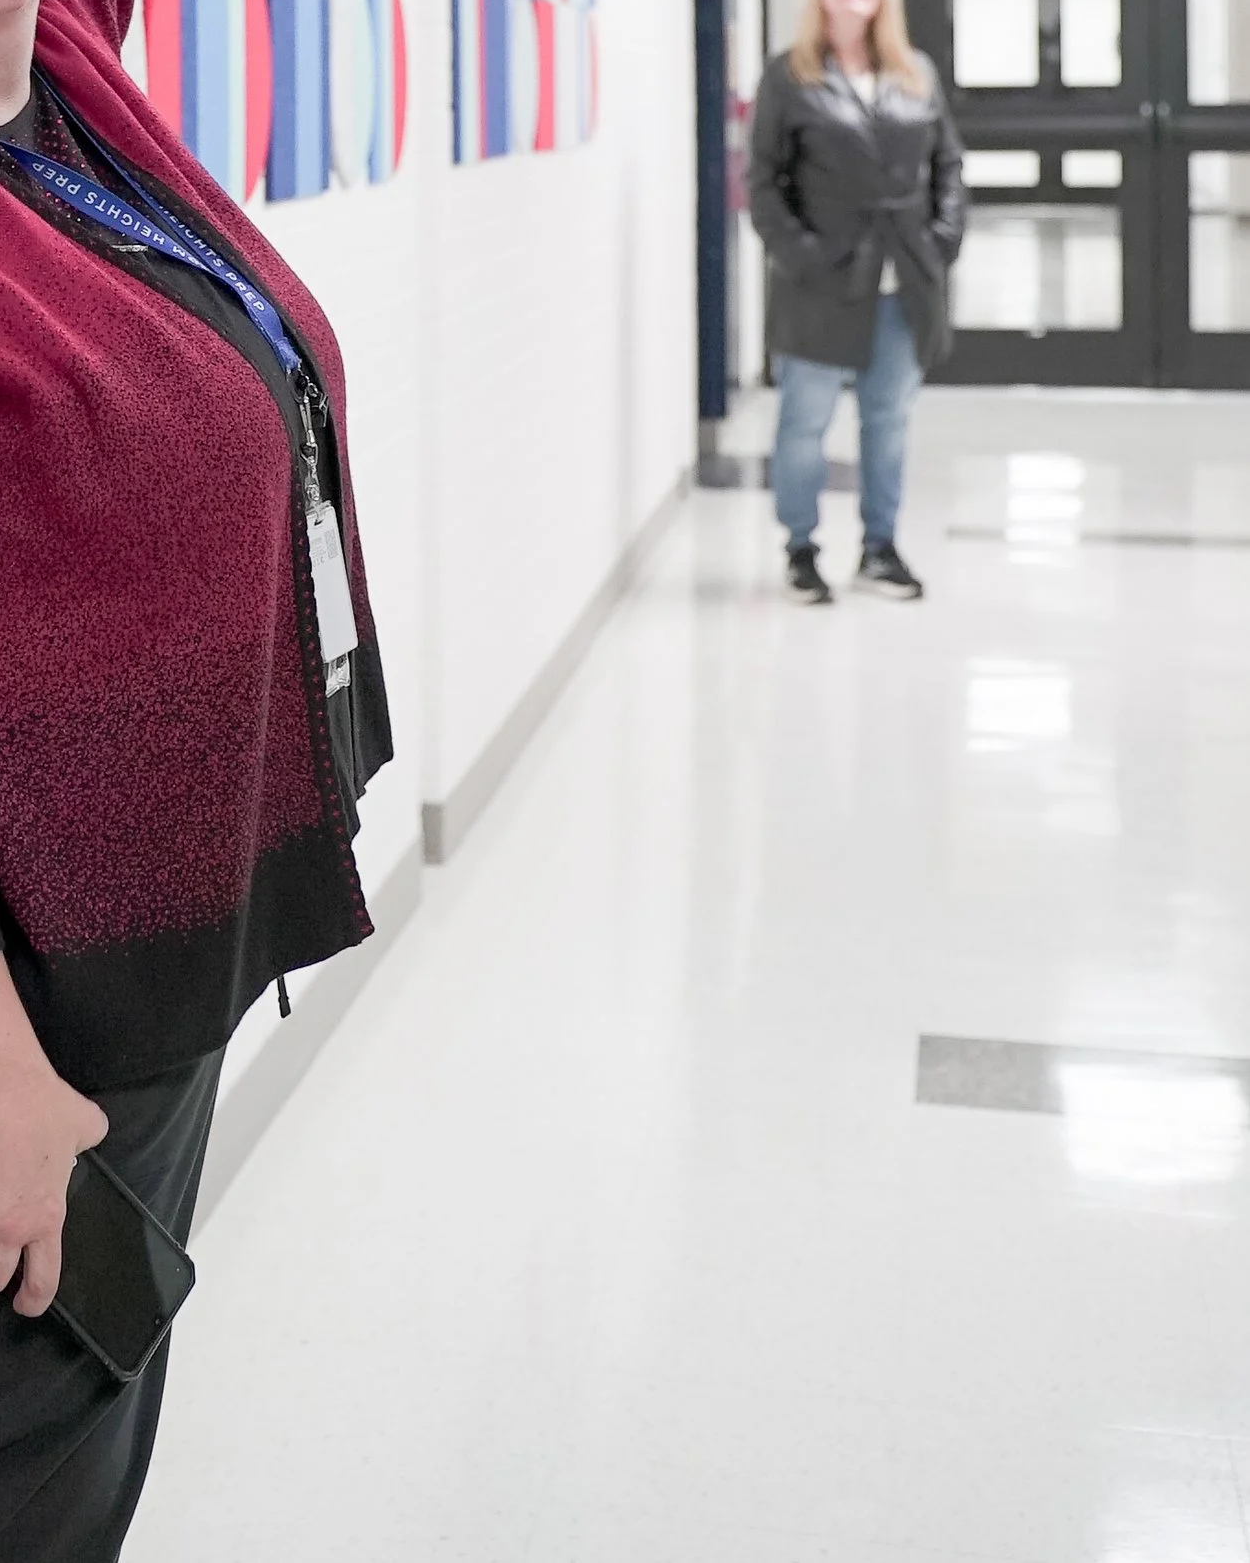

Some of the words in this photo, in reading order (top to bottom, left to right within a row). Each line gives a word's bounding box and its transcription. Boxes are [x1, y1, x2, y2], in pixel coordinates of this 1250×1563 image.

[32, 162, 82, 196] PREP
[84, 191, 165, 246] HEIGHTS
[225, 271, 266, 312] PREP
